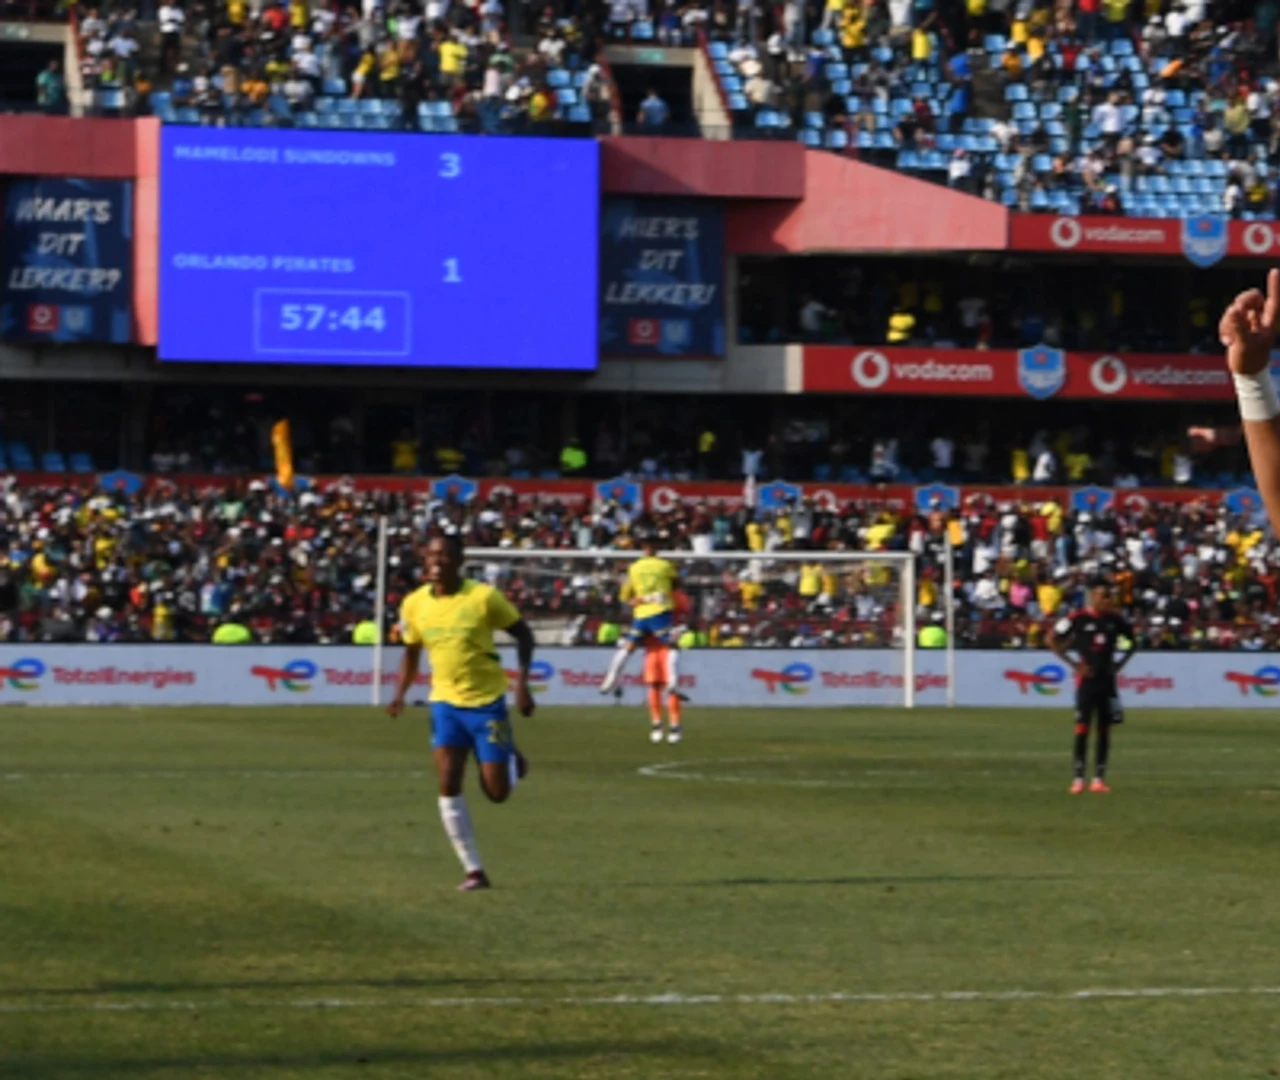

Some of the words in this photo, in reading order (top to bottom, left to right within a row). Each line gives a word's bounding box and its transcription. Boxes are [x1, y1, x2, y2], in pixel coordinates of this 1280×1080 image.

[173, 146, 278, 164] MAMELODI
[284, 148, 396, 167] SUNDOWNS
[439, 152, 461, 178] 3
[38, 231, 86, 255] DIT
[1085, 225, 1165, 243] vodacom
[173, 253, 268, 270] ORLANDO
[273, 256, 355, 273] PIRATES
[442, 258, 462, 282] 1
[639, 249, 684, 271] DIT
[280, 304, 386, 331] 57:44
[893, 361, 994, 381] vodacom
[1131, 365, 1228, 385] vodacom
[52, 665, 195, 692] TotalEnergies
